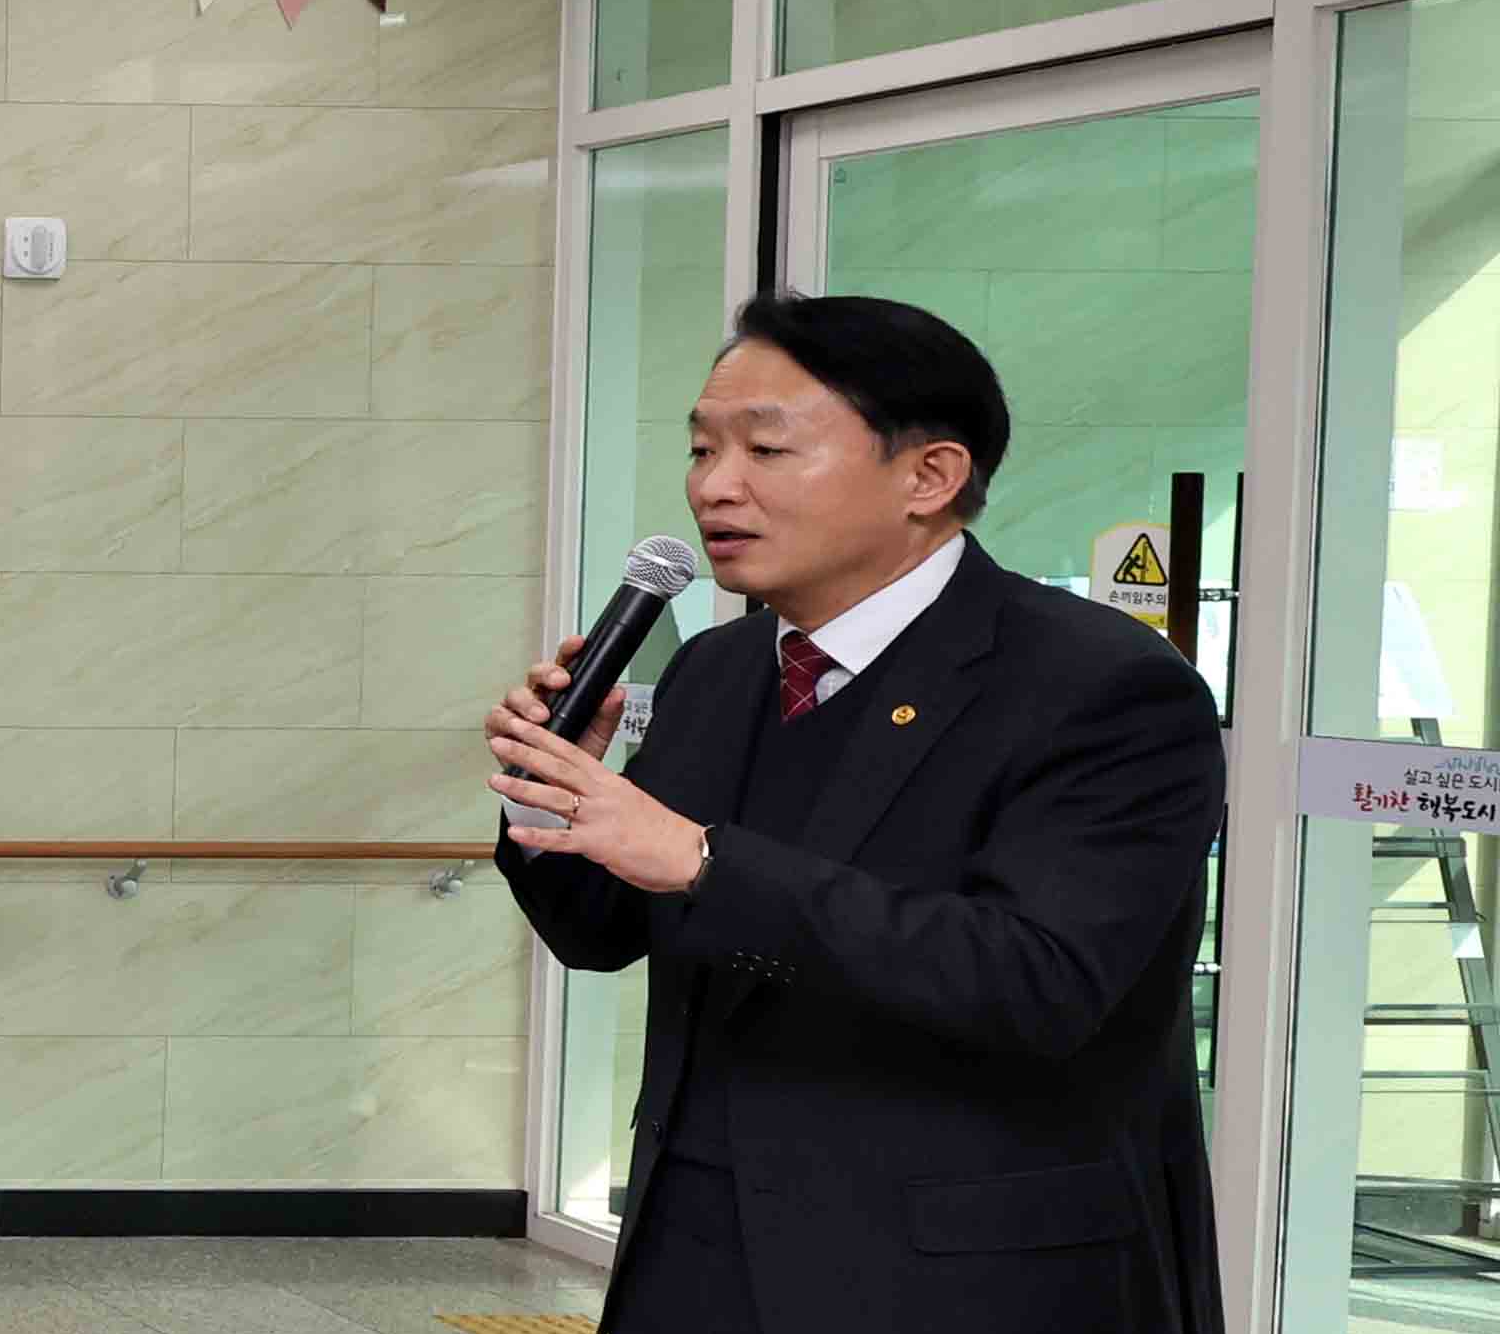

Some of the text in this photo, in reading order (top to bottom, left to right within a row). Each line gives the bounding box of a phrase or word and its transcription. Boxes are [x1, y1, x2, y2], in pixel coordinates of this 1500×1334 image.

[1404, 768, 1500, 793] 살고 싶은 도시
[1352, 782, 1497, 822] 활기찬 행복도시
